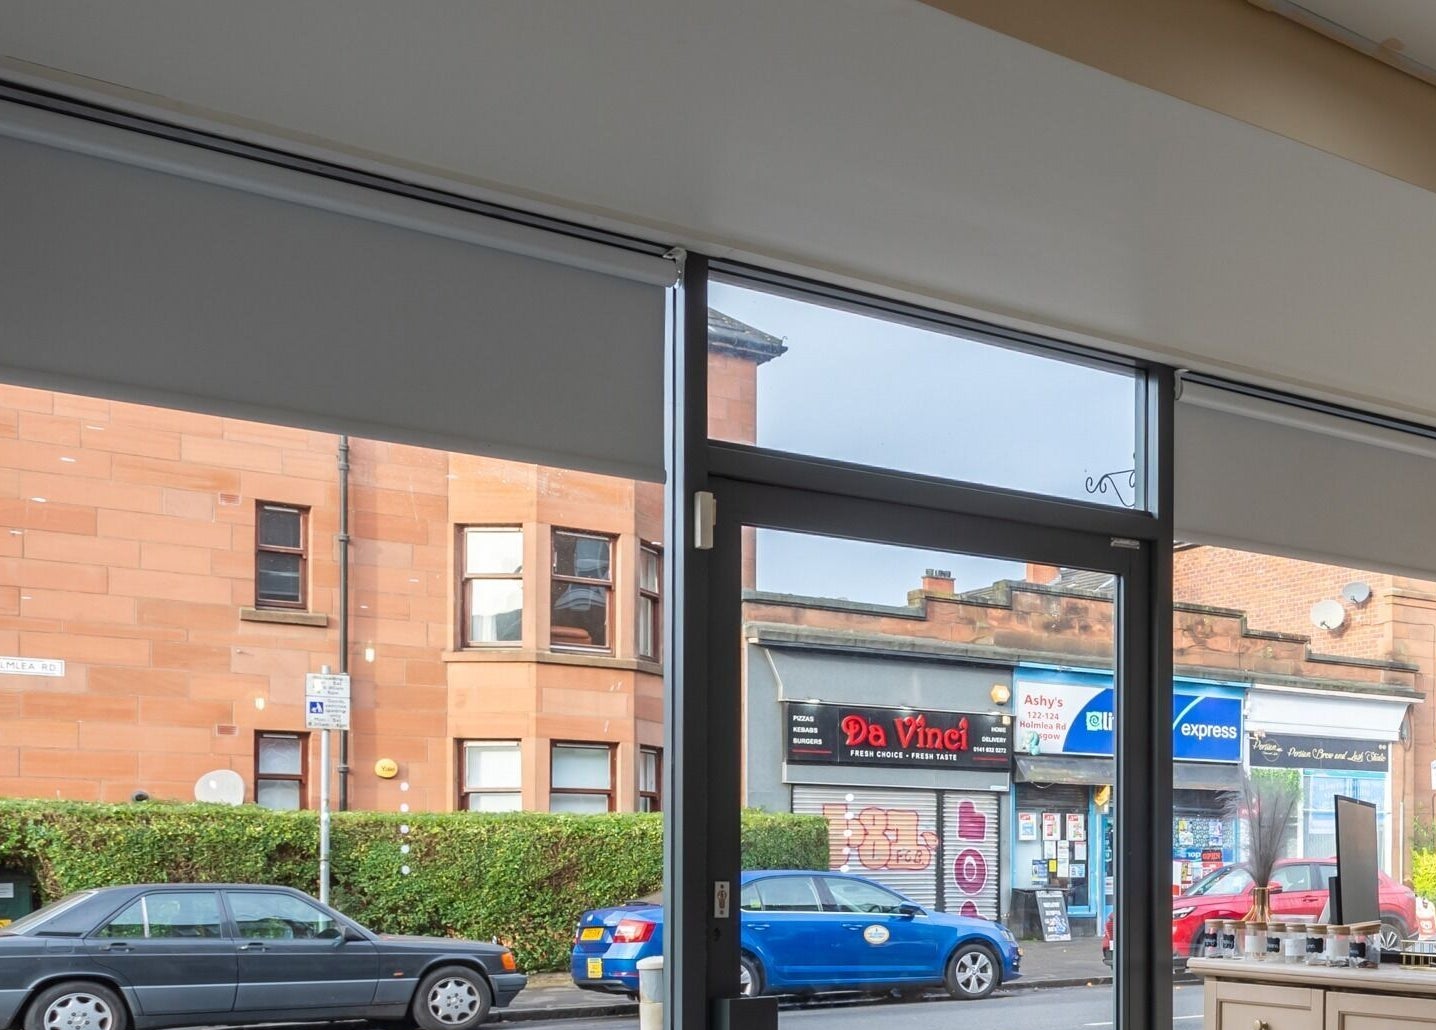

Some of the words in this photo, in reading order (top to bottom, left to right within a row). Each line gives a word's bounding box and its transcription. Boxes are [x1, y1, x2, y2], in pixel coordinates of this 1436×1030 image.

[41, 663, 56, 672] RD
[1024, 694, 1063, 709] Ashy's
[792, 715, 814, 723] PIZZAS
[1027, 711, 1060, 721] 122-124
[792, 726, 818, 734] KEBABS
[1019, 721, 1053, 730] Holmlea
[1056, 722, 1067, 731] Rd
[841, 714, 887, 747] Da
[893, 713, 969, 751] Vinci
[1181, 723, 1237, 740] express
[792, 737, 822, 745] BURGERS
[981, 736, 1007, 744] DELIVERY
[850, 749, 874, 758] FRESH
[876, 751, 903, 759] CHOICE
[911, 752, 934, 760] FRESH
[936, 753, 957, 761] TASTE
